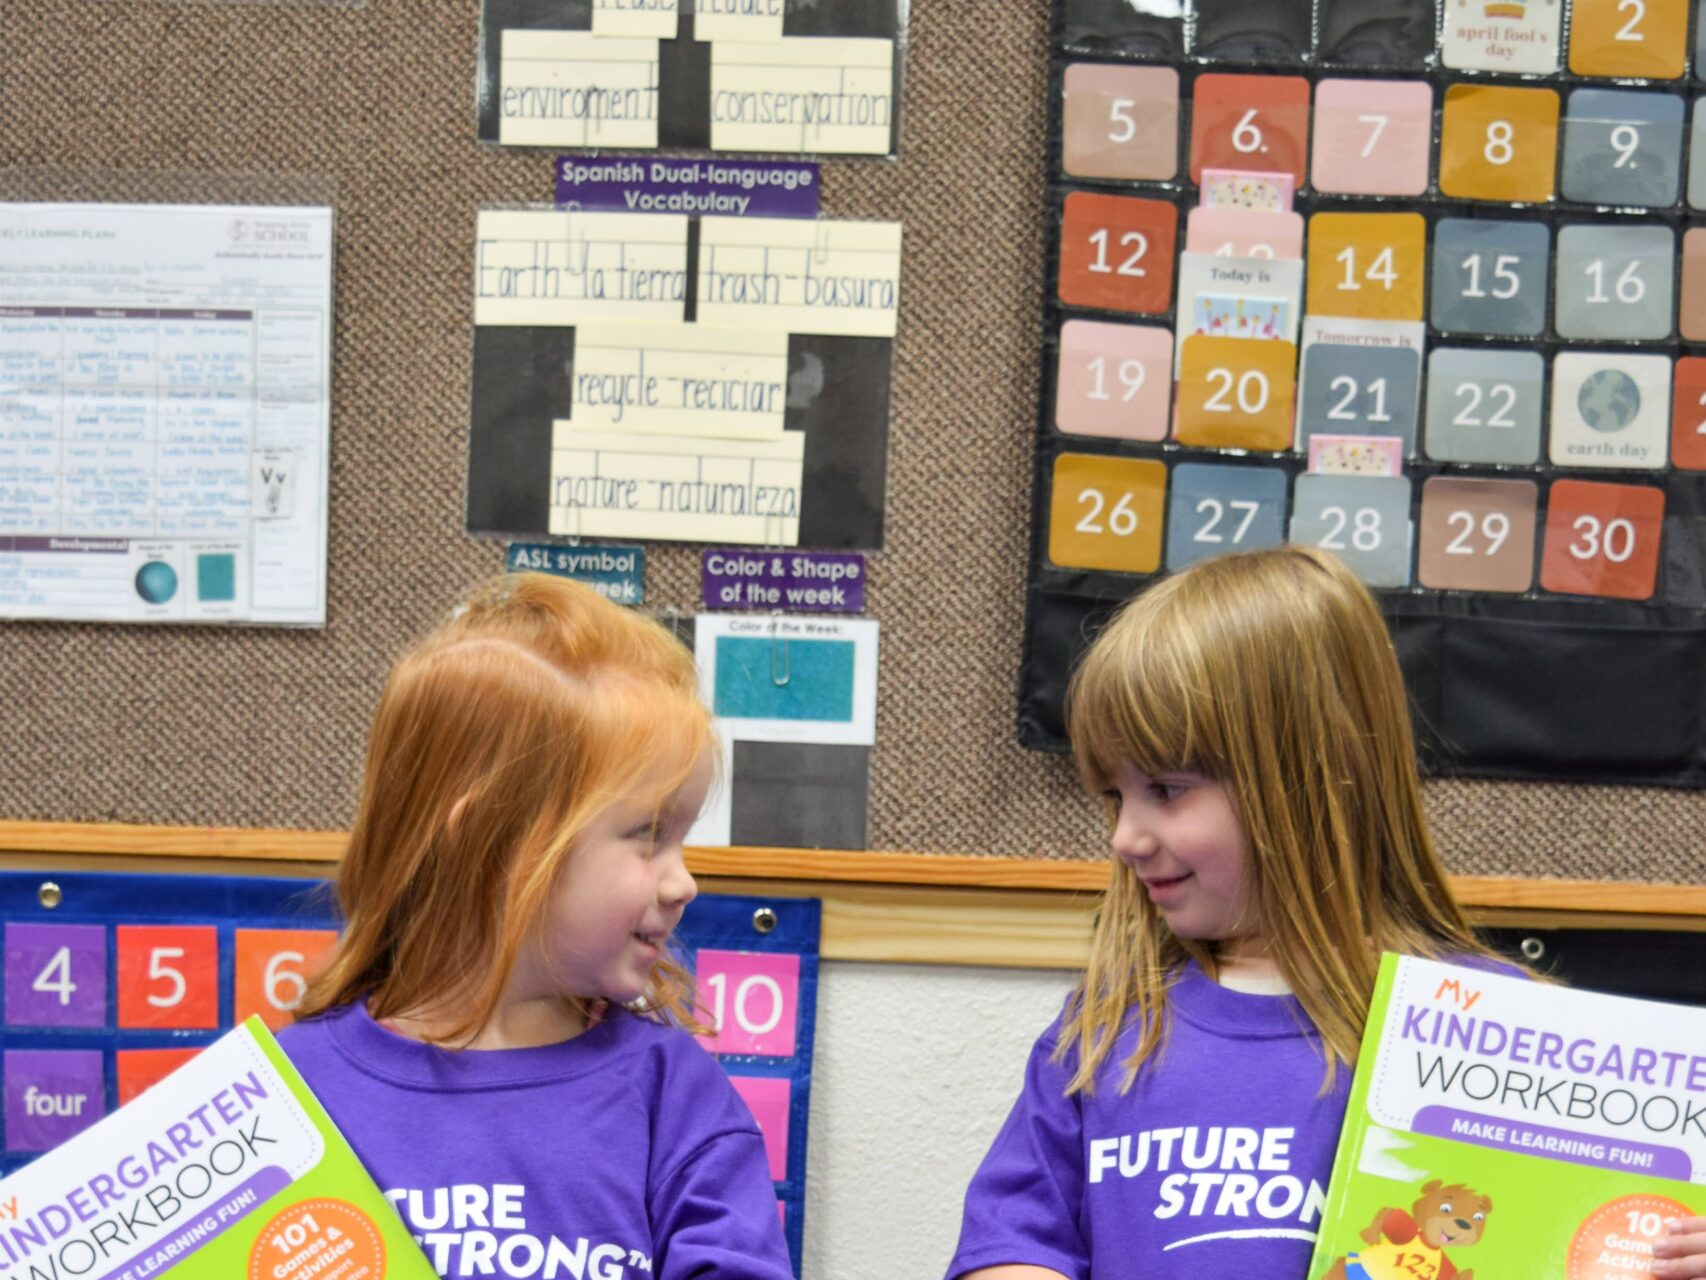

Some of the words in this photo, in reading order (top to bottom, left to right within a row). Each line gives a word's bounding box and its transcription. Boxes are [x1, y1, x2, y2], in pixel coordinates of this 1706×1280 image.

[1457, 26, 1498, 42] april
[1615, 0, 1646, 41] 2
[1486, 42, 1515, 59] day
[503, 61, 658, 119] enviroment
[712, 66, 889, 126] conservation
[1108, 98, 1136, 143] 5
[1358, 114, 1388, 158] 7
[1484, 120, 1514, 165] 8
[562, 161, 644, 186] Spanish
[651, 163, 812, 190] Dual-language
[624, 190, 750, 214] Vocabulary
[1087, 228, 1148, 277] 12
[1336, 246, 1398, 290] 14
[1210, 267, 1253, 284] Today
[1257, 270, 1271, 283] is
[1461, 254, 1520, 299] 15
[1584, 260, 1646, 304] 16
[1086, 356, 1145, 402] 19
[1203, 367, 1269, 414] 20
[1327, 375, 1391, 422] 21
[1453, 383, 1517, 428] 22
[1567, 442, 1614, 457] earth
[1619, 443, 1650, 461] day
[261, 467, 273, 483] V
[555, 450, 639, 509] nature
[1075, 488, 1138, 536] 26
[1193, 498, 1260, 543] 27
[1317, 506, 1382, 551] 28
[1444, 510, 1510, 556] 29
[515, 549, 552, 568] ASL
[557, 553, 635, 573] symbol
[1569, 515, 1636, 562] 30
[707, 555, 765, 576] Color
[770, 558, 785, 577] &
[791, 558, 860, 582] Shape
[720, 582, 742, 602] of
[746, 584, 781, 603] the
[786, 586, 845, 605] week
[728, 621, 762, 632] Color
[766, 622, 777, 632] of
[781, 622, 800, 632] the
[32, 946, 76, 1006] 4
[146, 947, 187, 1008] 5
[263, 951, 307, 1012] 6
[1435, 978, 1481, 1011] My
[706, 973, 783, 1035] 10
[24, 1086, 87, 1117] four
[1416, 1051, 1706, 1138] WORKBOOK
[1089, 1127, 1294, 1183] FUTURE
[1451, 1118, 1506, 1143] MAKE
[1509, 1132, 1605, 1161] LEARNING
[1608, 1149, 1654, 1168] FUN!
[137, 1217, 219, 1276] LEARNING
[218, 1188, 258, 1223] FUN!
[272, 1213, 320, 1254] 101
[272, 1238, 328, 1279] Games
[326, 1226, 343, 1241] &
